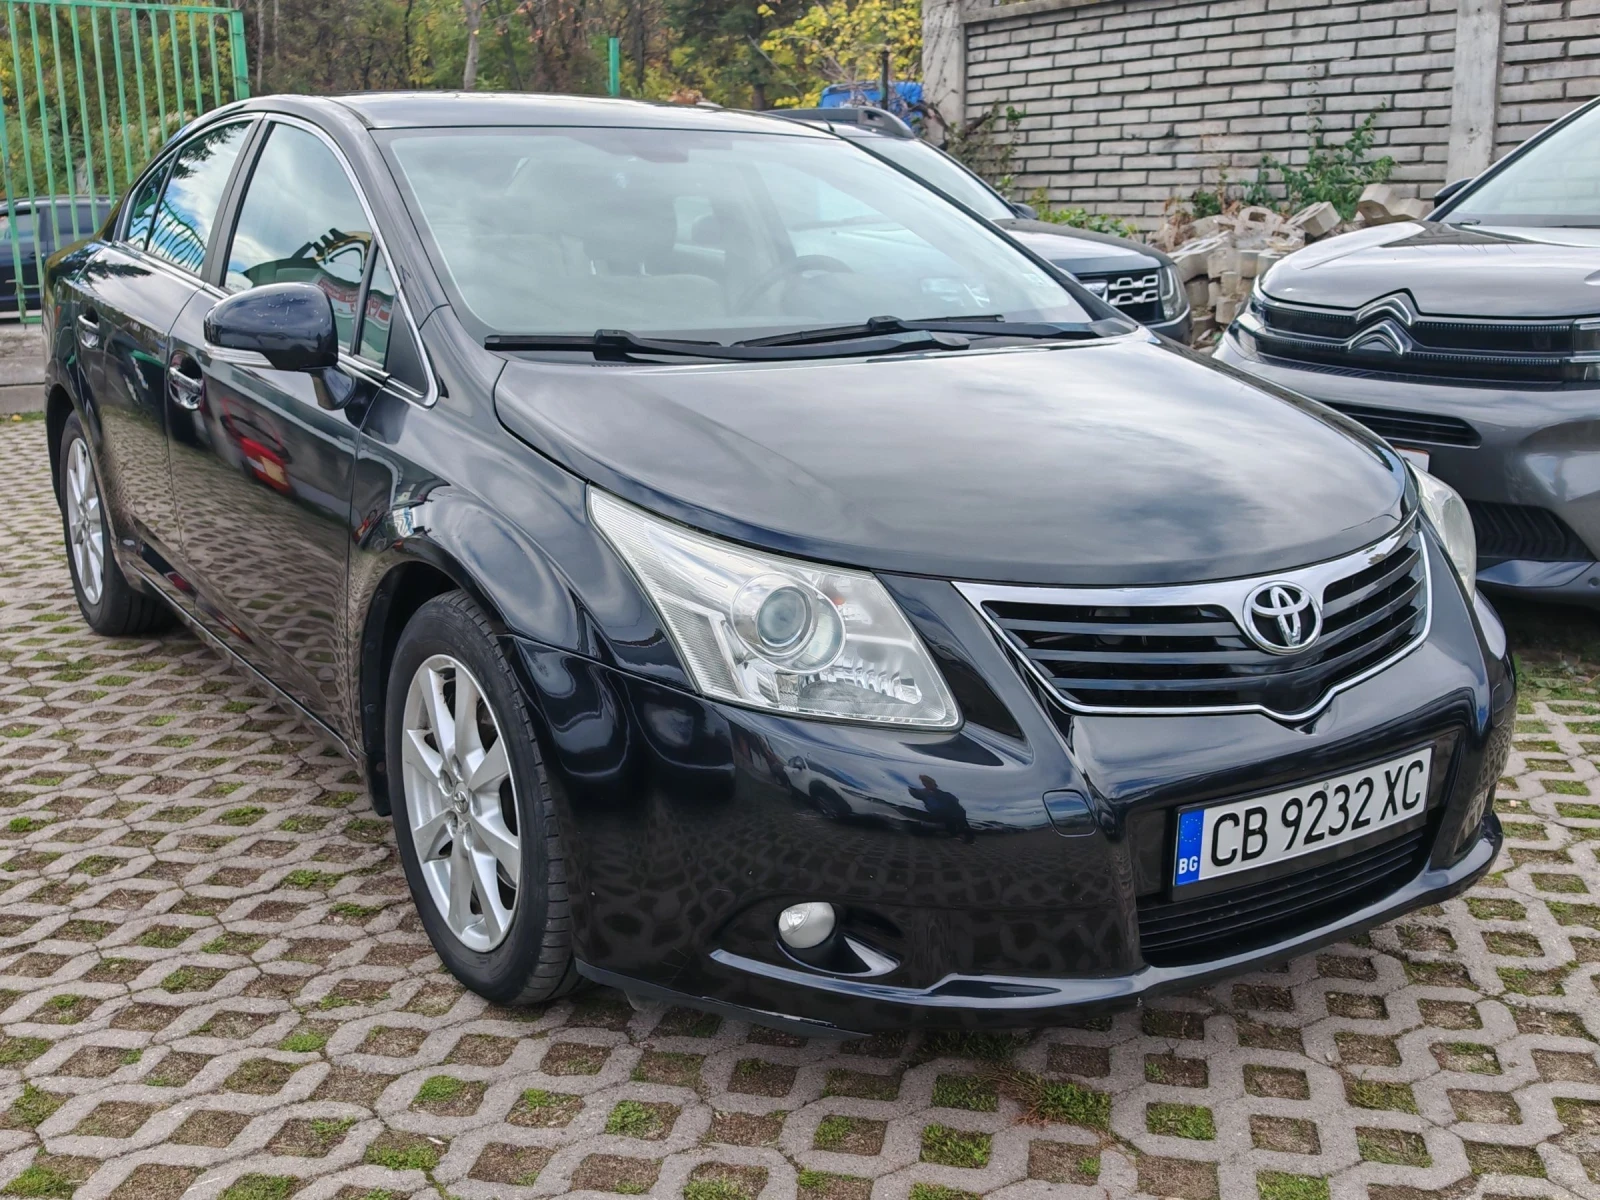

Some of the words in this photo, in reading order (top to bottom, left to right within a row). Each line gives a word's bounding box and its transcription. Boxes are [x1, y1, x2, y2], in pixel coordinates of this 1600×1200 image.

[1211, 805, 1267, 867] CB
[1281, 776, 1374, 851] 9232
[1379, 759, 1424, 822] XC
[1178, 856, 1199, 875] BG
